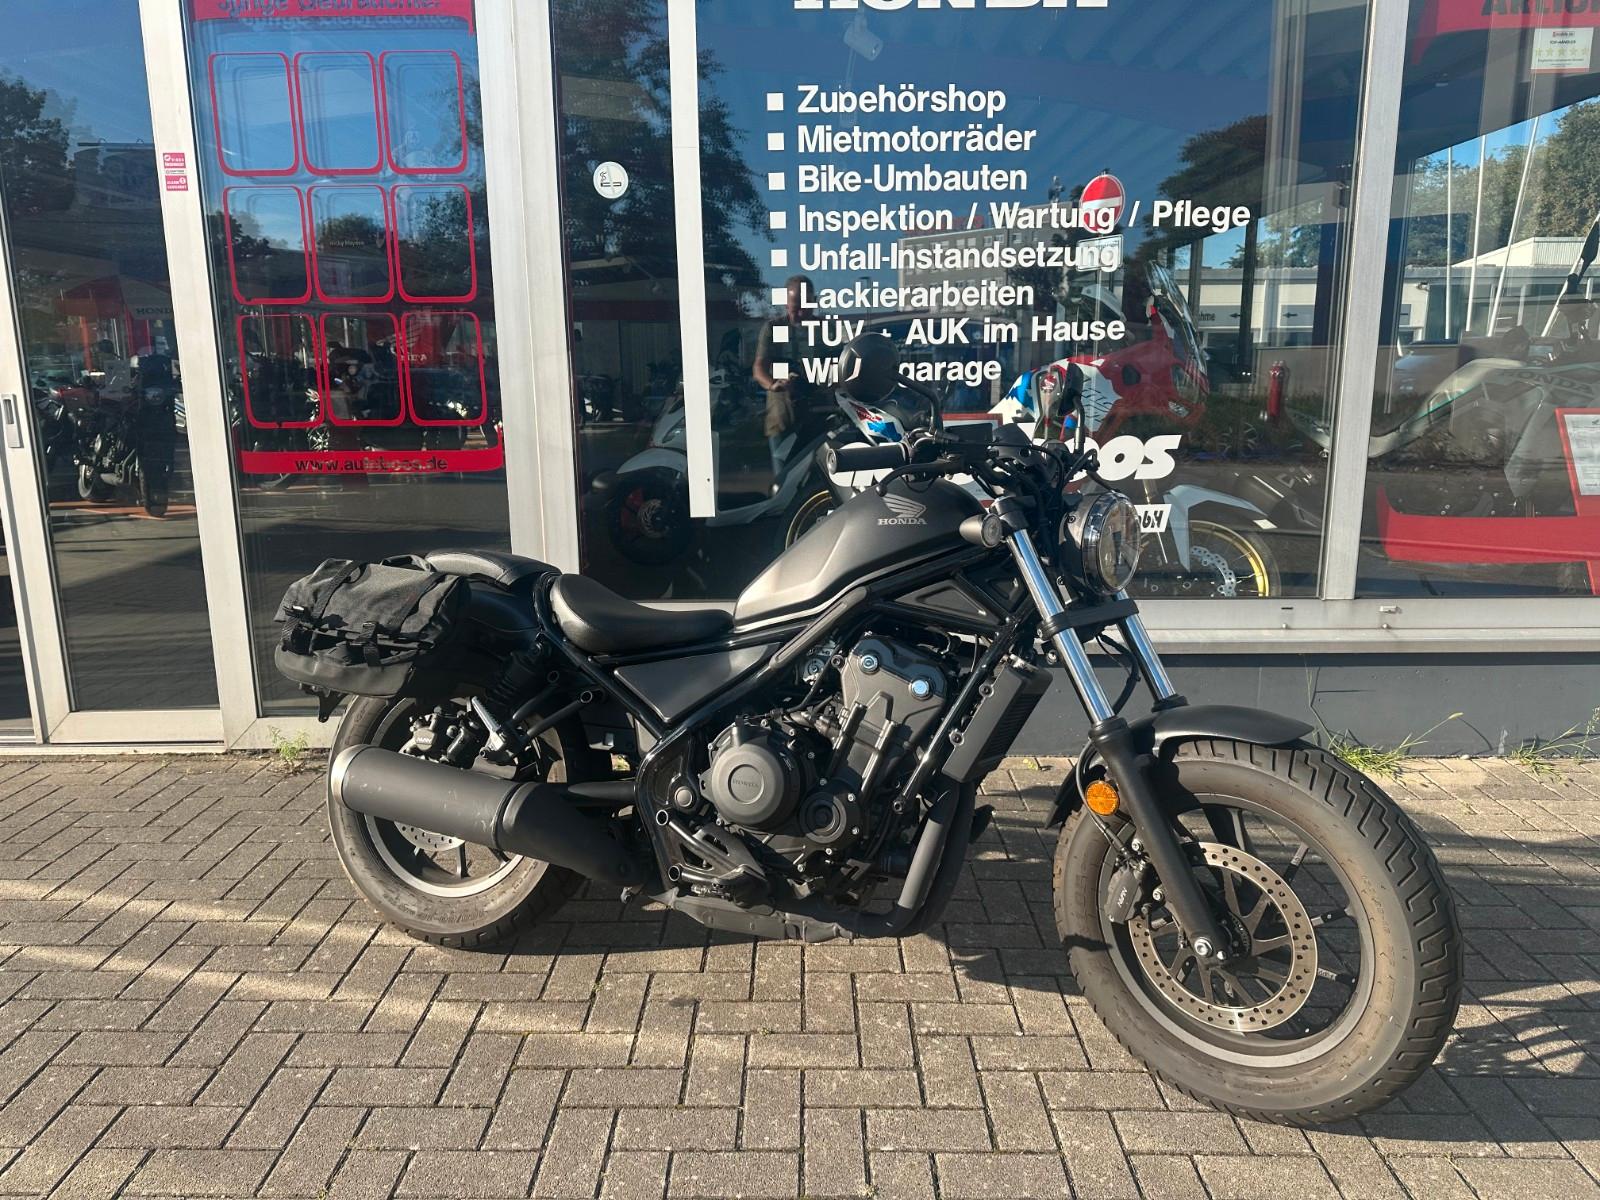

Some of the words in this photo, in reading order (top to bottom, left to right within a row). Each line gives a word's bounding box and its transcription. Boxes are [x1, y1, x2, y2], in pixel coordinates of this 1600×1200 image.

[797, 83, 1007, 119] Zubehörshop
[798, 123, 1037, 153] Mietmotorräder
[798, 163, 1028, 193] Bike-Umbauten
[799, 203, 953, 238] Inspektion
[966, 202, 979, 230] /
[989, 202, 1116, 235] Wartung
[1128, 200, 1141, 228] /
[1152, 199, 1251, 234] Pflege
[799, 240, 1121, 273] Unfall-Instandsetzung
[800, 279, 1035, 309] Lackierarbeiten
[801, 314, 865, 347] TÜV
[904, 317, 970, 345] AUK
[983, 316, 1018, 344] im
[1031, 314, 1125, 342] Hause
[802, 357, 1002, 388] Wigarage
[877, 517, 928, 526] HONDA
